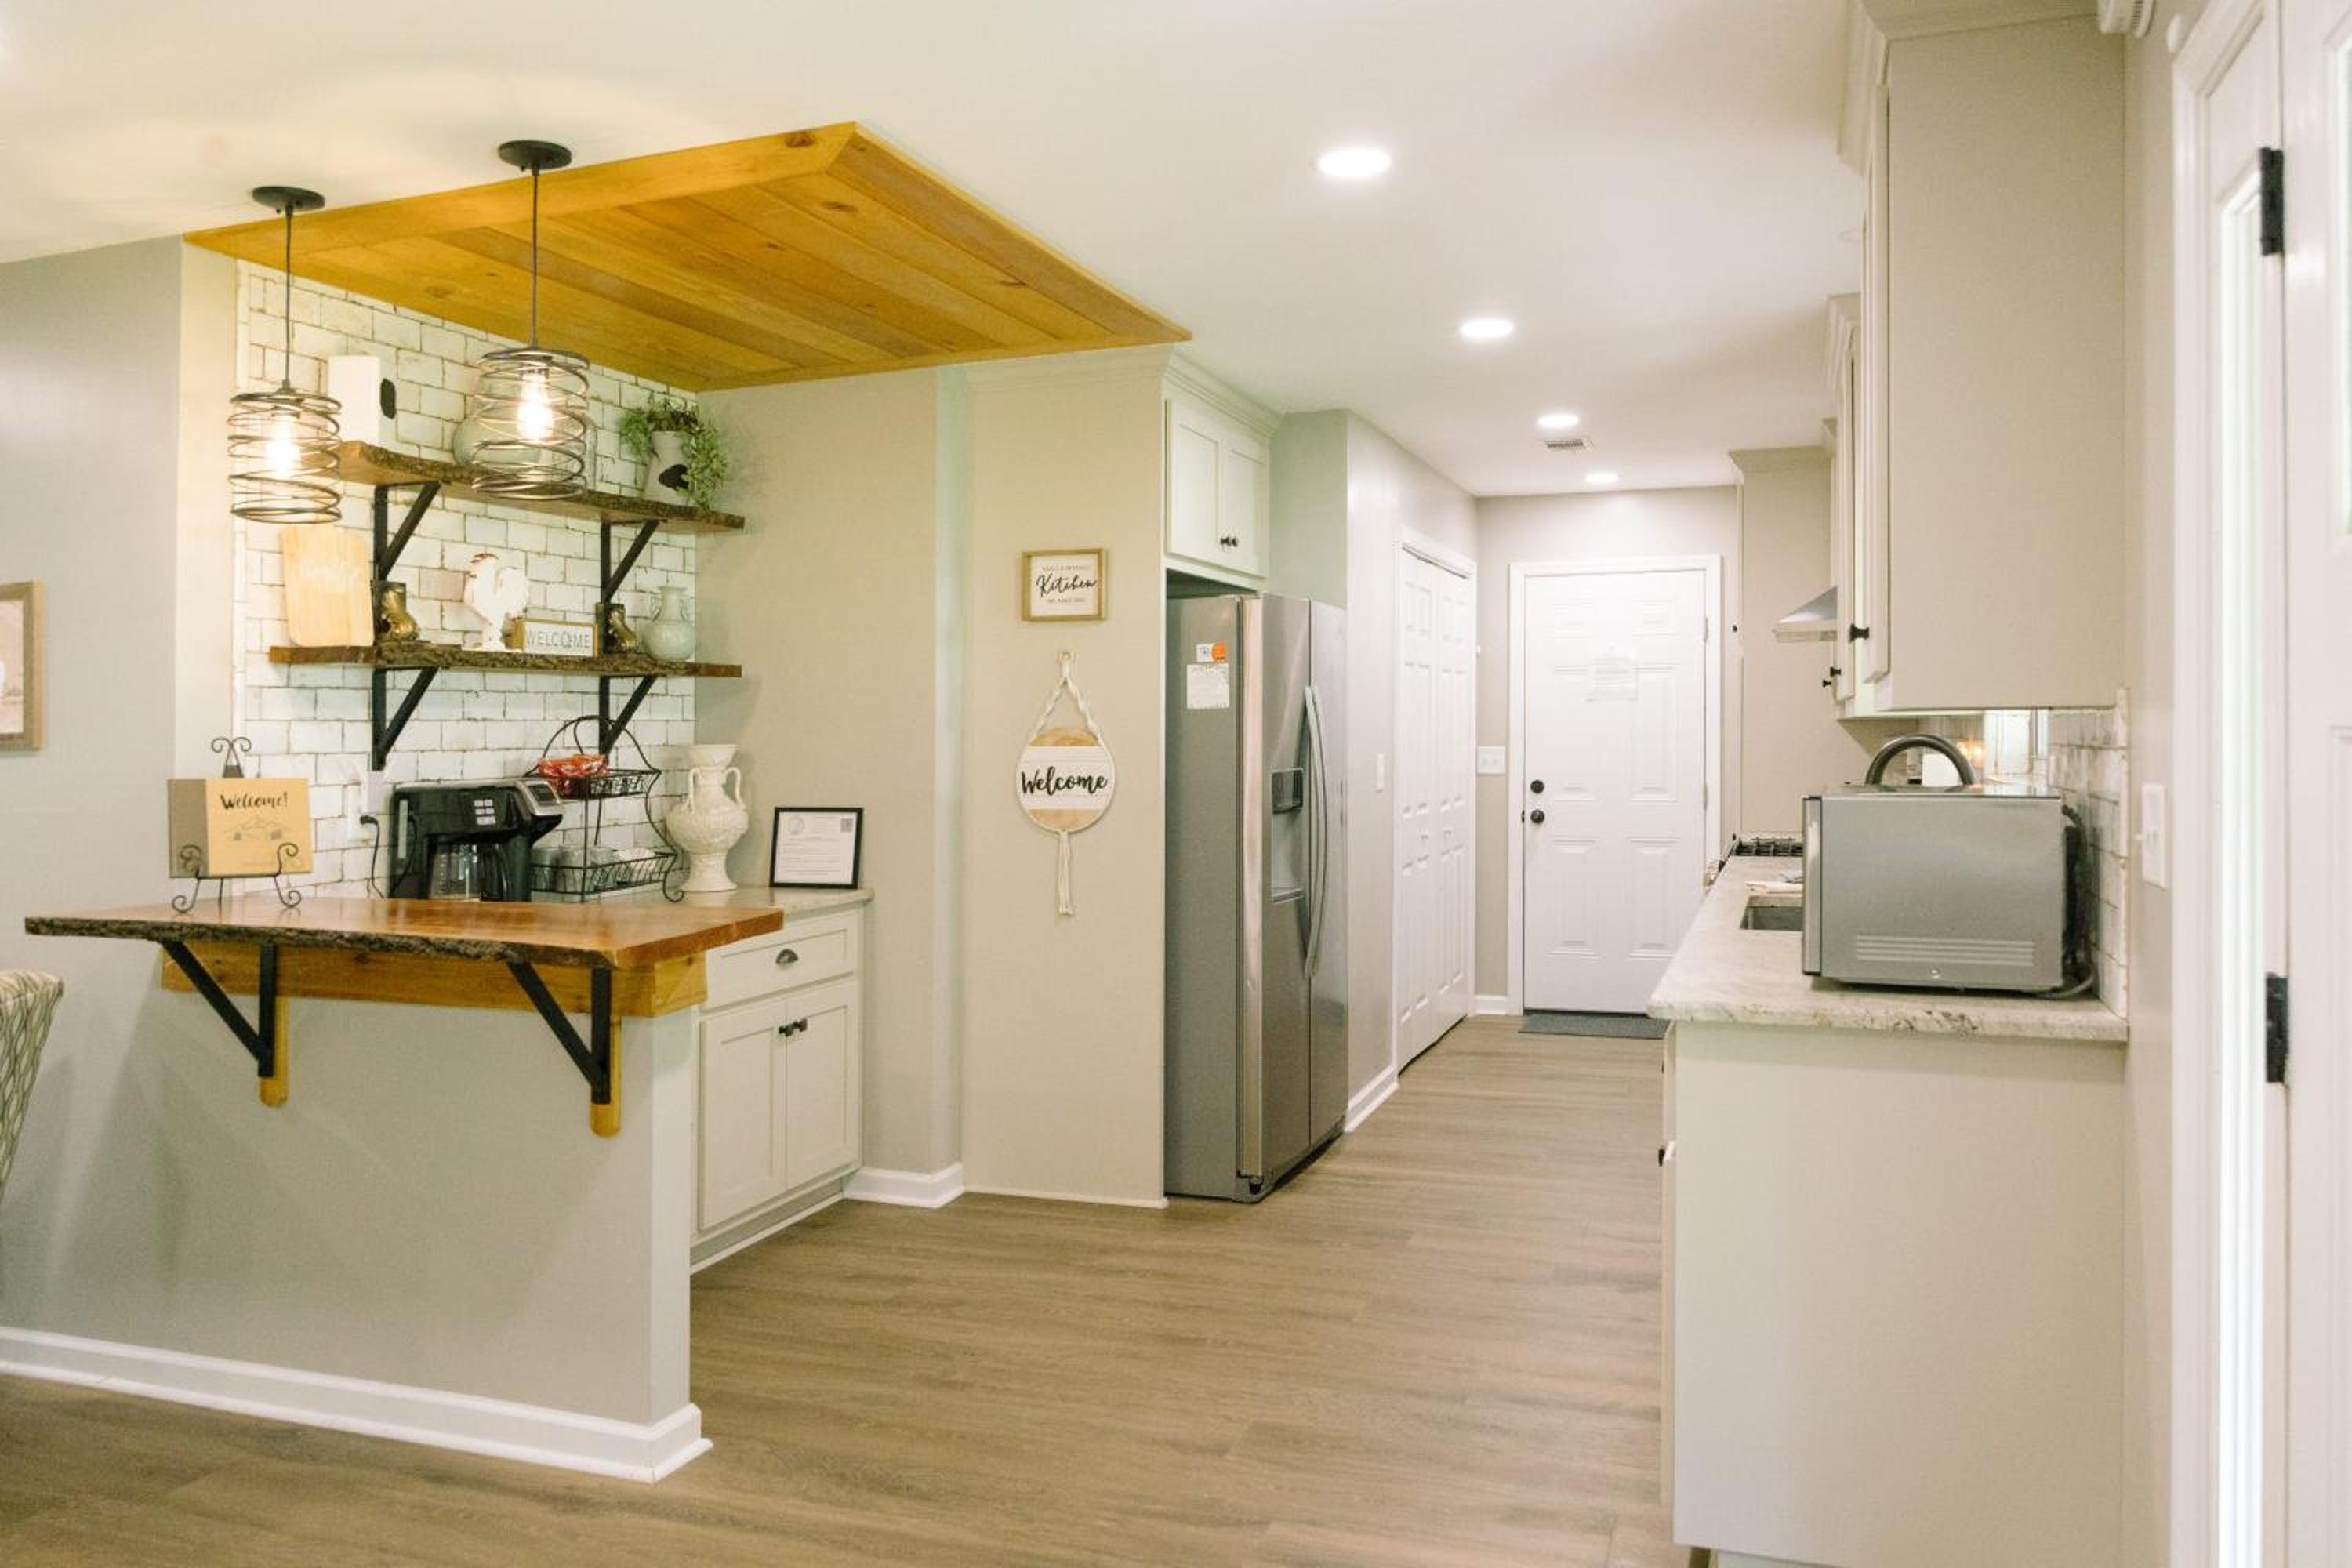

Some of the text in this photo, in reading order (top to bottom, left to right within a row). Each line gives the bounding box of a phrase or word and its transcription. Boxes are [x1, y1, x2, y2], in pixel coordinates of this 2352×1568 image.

[1036, 572, 1097, 597] Kitchen
[527, 630, 590, 648] WELCOME
[1021, 766, 1108, 796] Welcome
[220, 791, 288, 809] Welcome!
